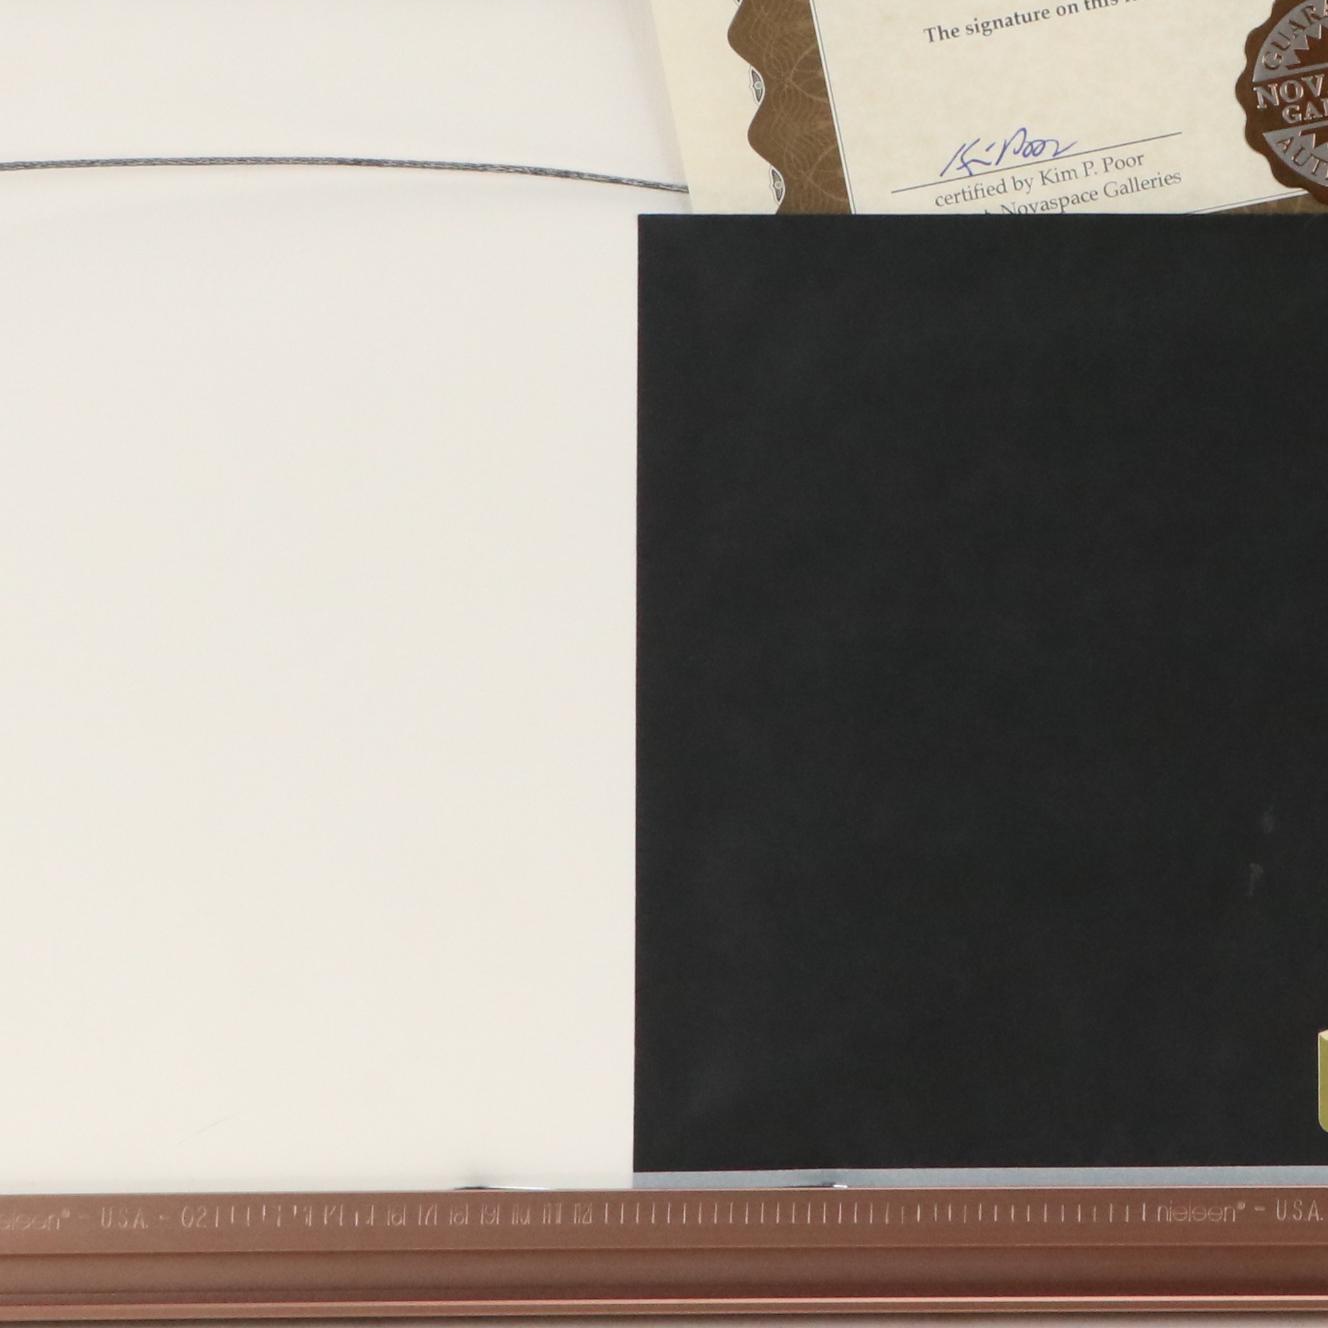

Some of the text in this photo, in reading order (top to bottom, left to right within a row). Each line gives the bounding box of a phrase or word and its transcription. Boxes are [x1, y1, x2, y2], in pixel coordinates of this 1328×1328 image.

[922, 23, 960, 43] The
[964, 7, 1051, 37] signature
[1054, 1, 1079, 17] on
[935, 153, 1145, 207] certified by Kim P. Poor
[1104, 171, 1182, 197] Galleries
